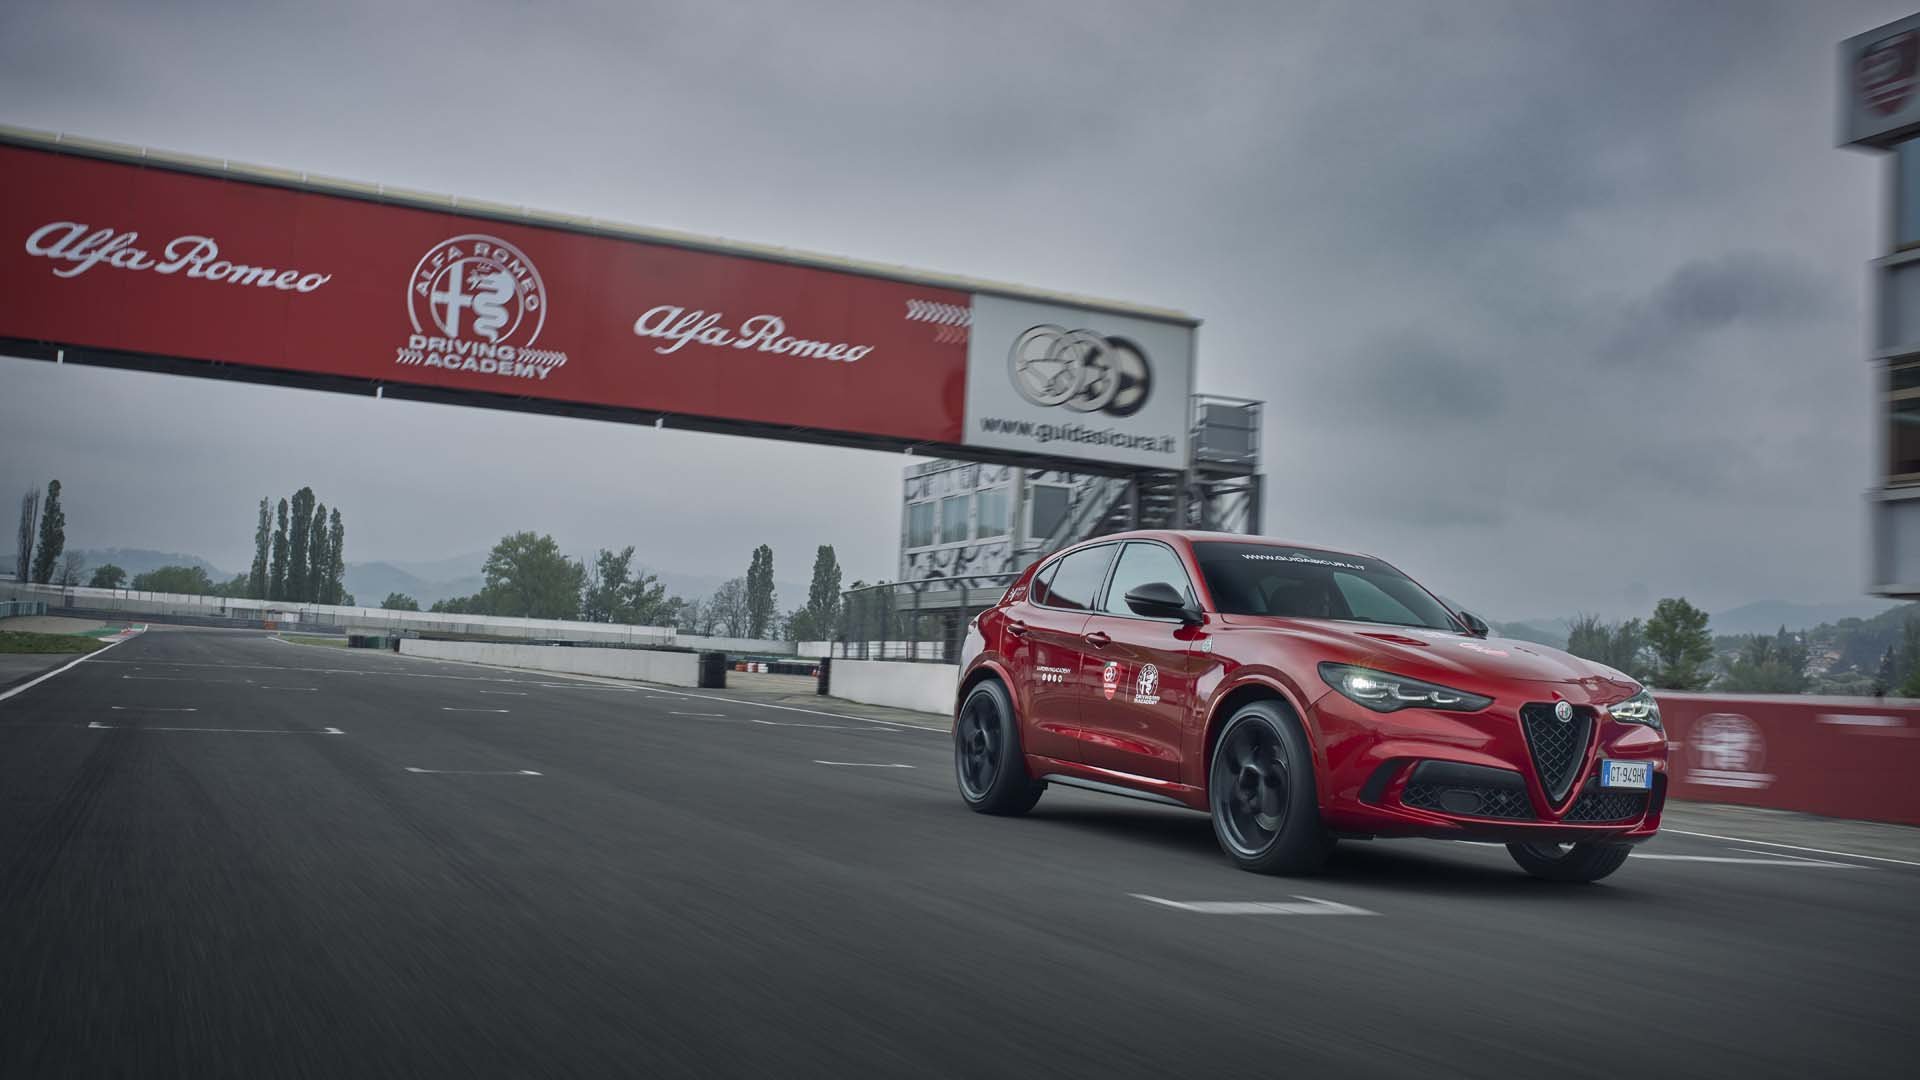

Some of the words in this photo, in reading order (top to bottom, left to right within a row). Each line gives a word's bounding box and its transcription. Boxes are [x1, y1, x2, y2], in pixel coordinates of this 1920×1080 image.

[25, 221, 156, 278] Alfa
[154, 235, 333, 293] Romeo
[415, 245, 464, 297] ALFA
[472, 242, 540, 312] ROMEO
[408, 333, 517, 361] DRIVING
[633, 304, 737, 355] Alfa
[732, 314, 875, 362] Romeo
[423, 352, 553, 381] ACADEMY
[979, 416, 1176, 453] www.guidasicura.it
